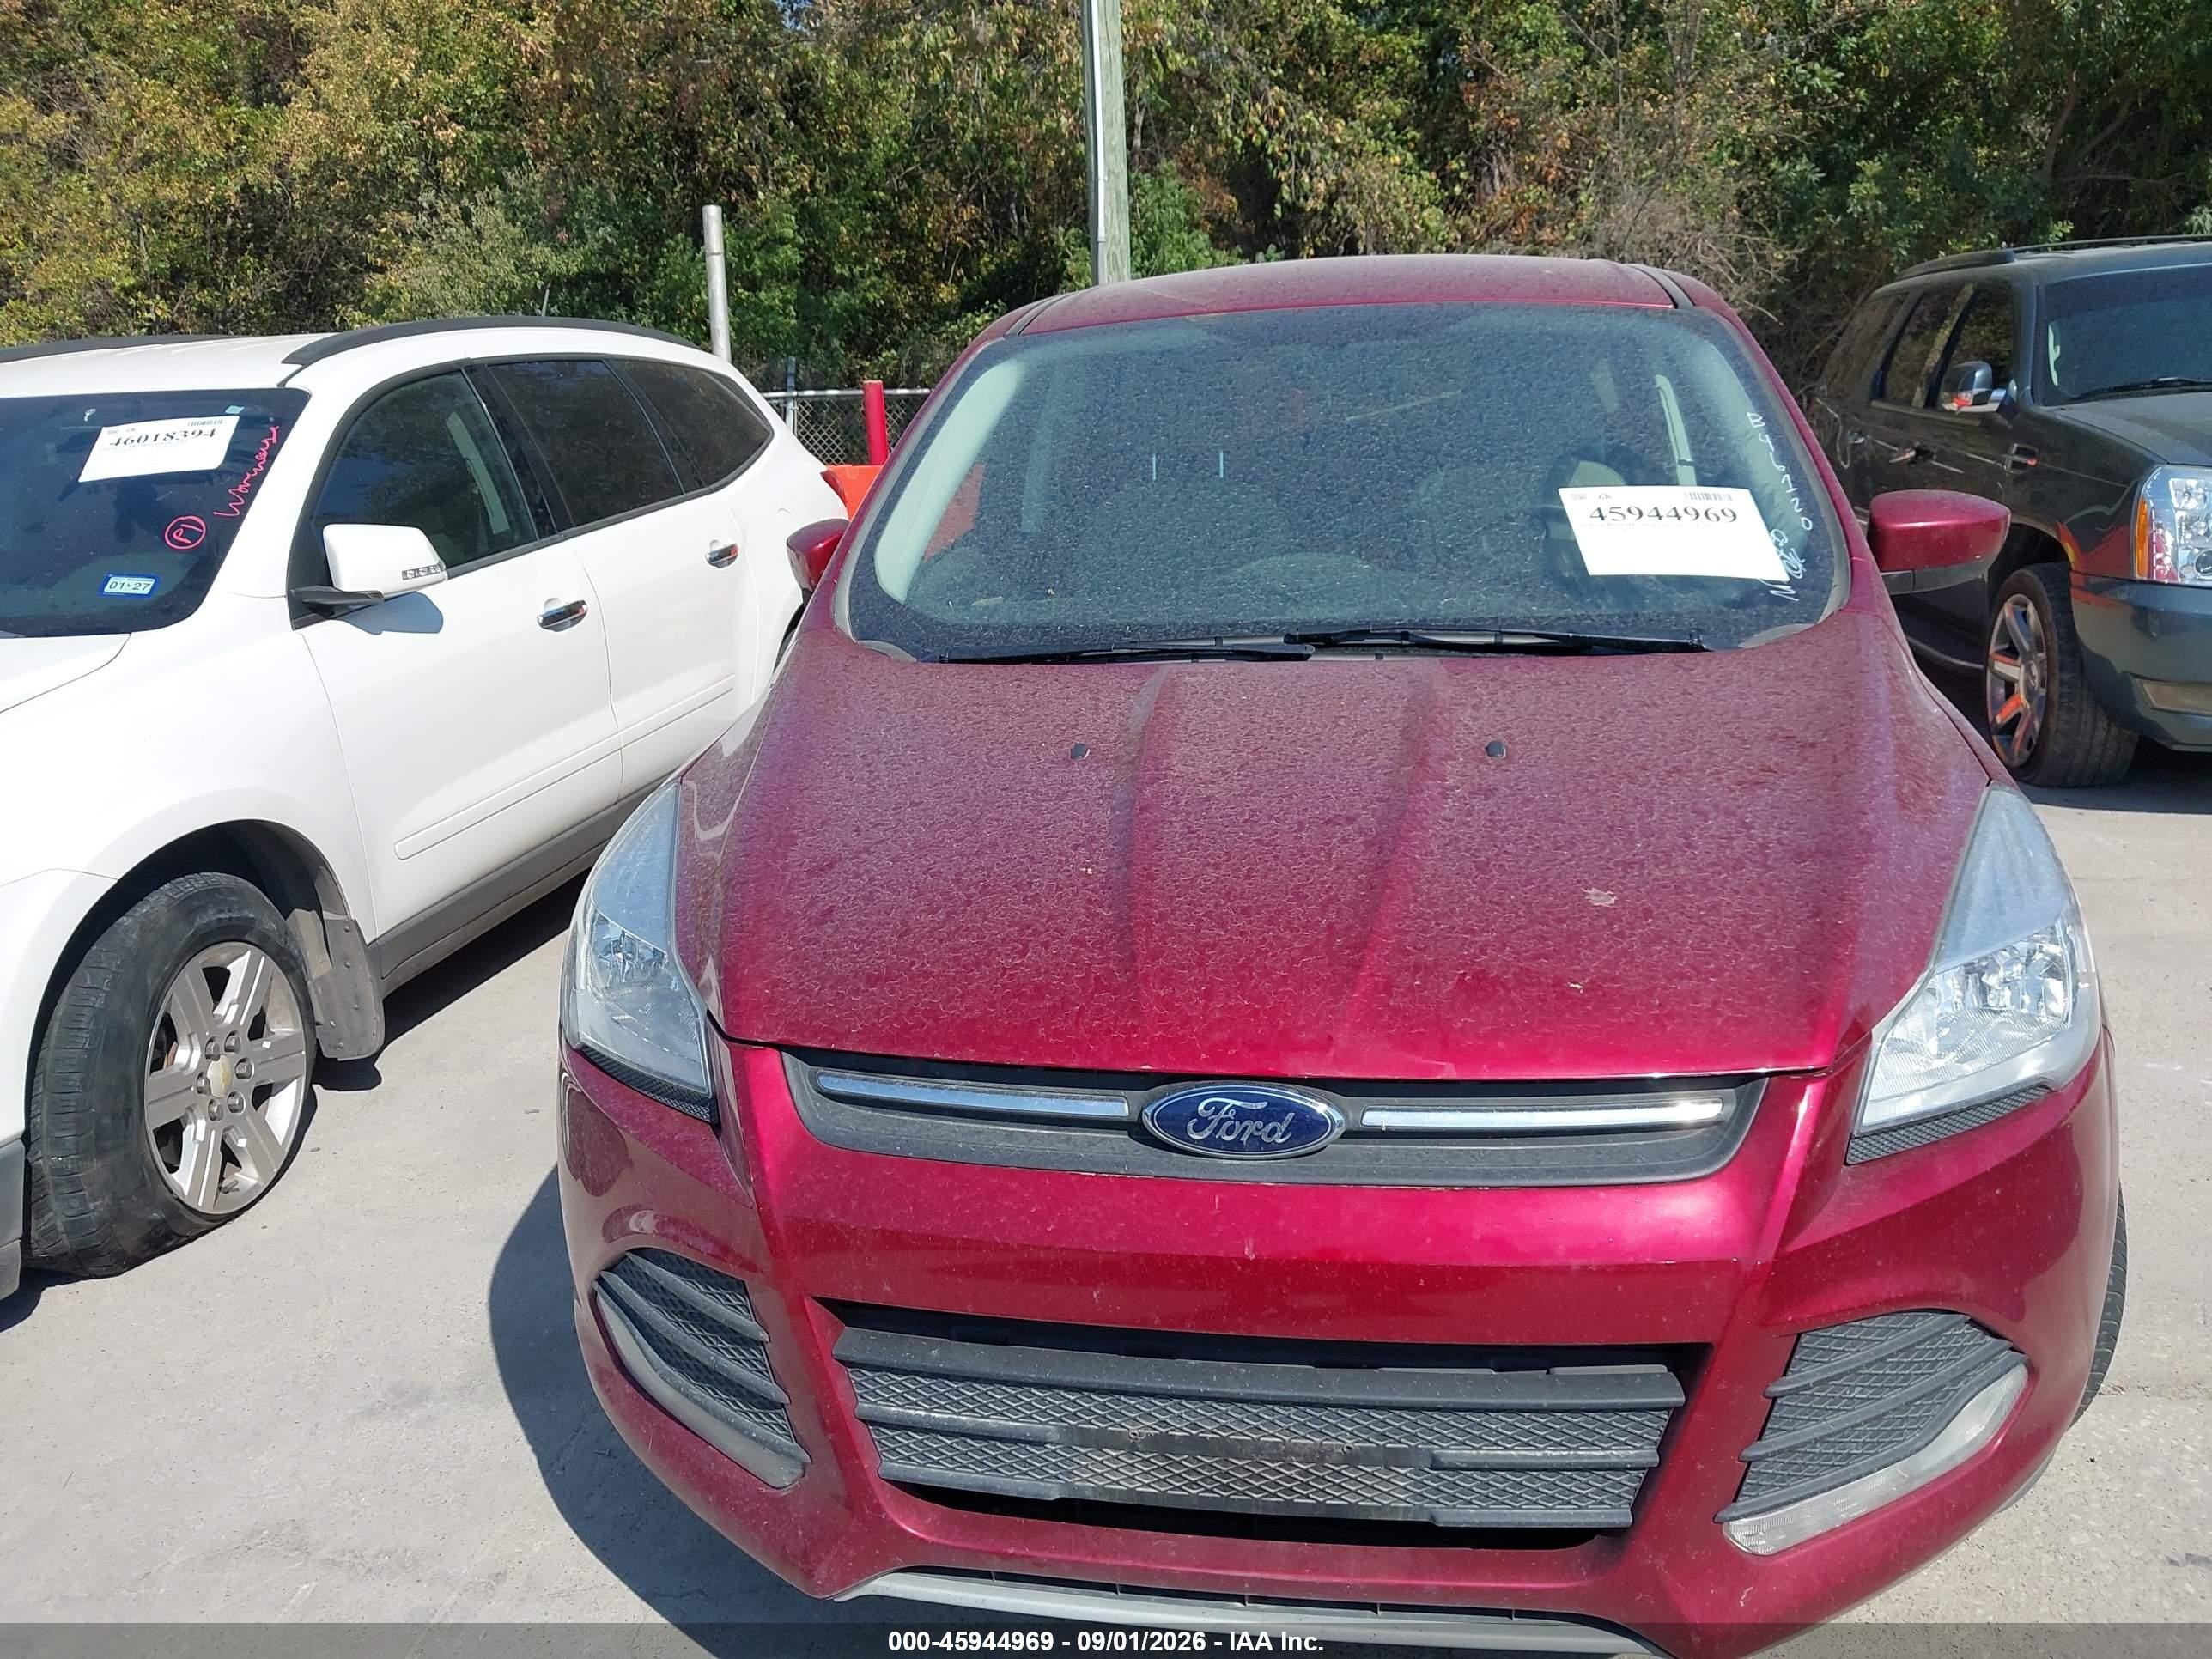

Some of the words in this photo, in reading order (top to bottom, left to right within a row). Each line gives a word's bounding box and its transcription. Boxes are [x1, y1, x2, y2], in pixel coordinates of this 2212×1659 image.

[110, 428, 216, 447] 46018394
[1589, 505, 1738, 523] 45944969
[1186, 1097, 1295, 1146] Ford
